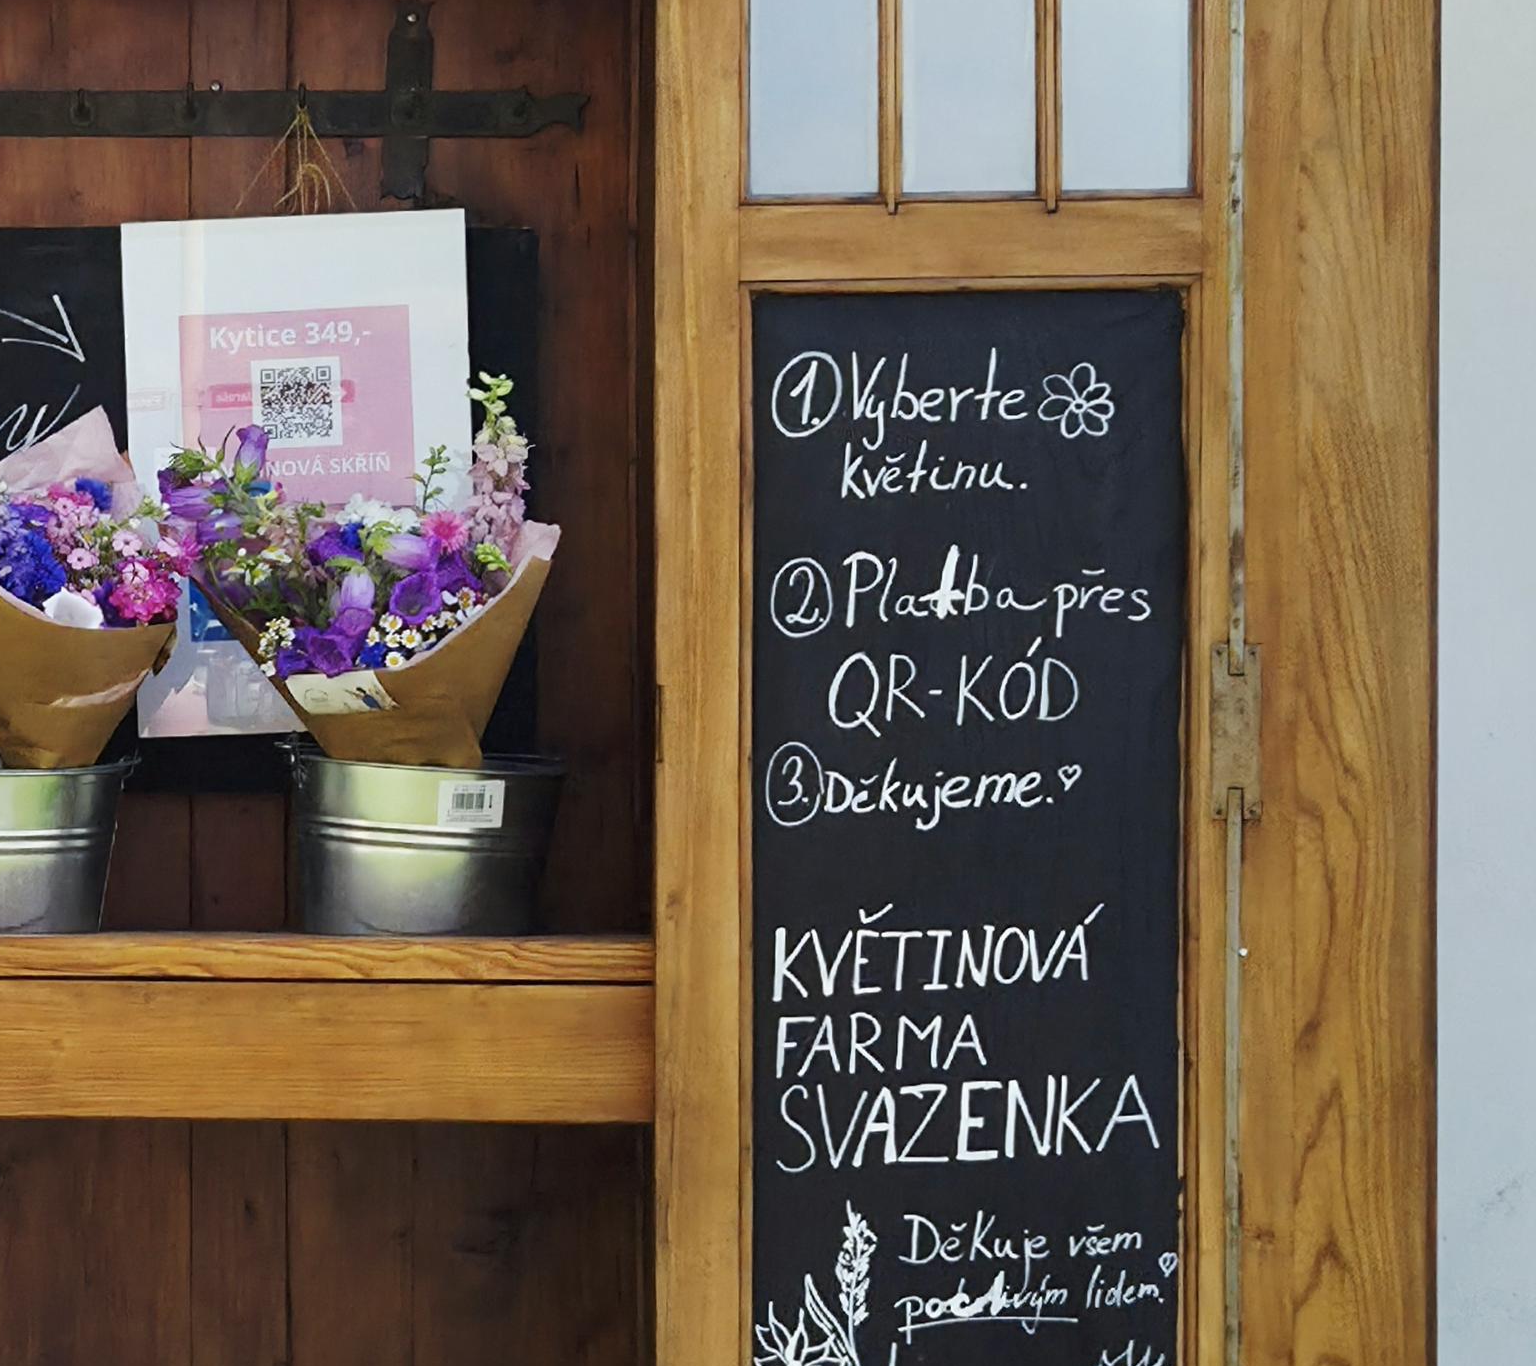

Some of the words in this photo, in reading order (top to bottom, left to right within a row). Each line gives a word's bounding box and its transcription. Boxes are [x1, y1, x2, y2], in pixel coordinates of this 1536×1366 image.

[209, 323, 297, 355] Kytice
[304, 320, 372, 347] 349,-
[850, 347, 1030, 450] Vyberte
[330, 450, 392, 475] SKŘÍŇ
[1052, 568, 1152, 638] přes
[827, 636, 1080, 738] QR-KÓD
[772, 902, 1105, 1002] KVĚTINOVÁ
[775, 1011, 988, 1079] FARMA
[775, 1074, 1161, 1173] SVAZENKA
[1069, 1222, 1143, 1258] všem
